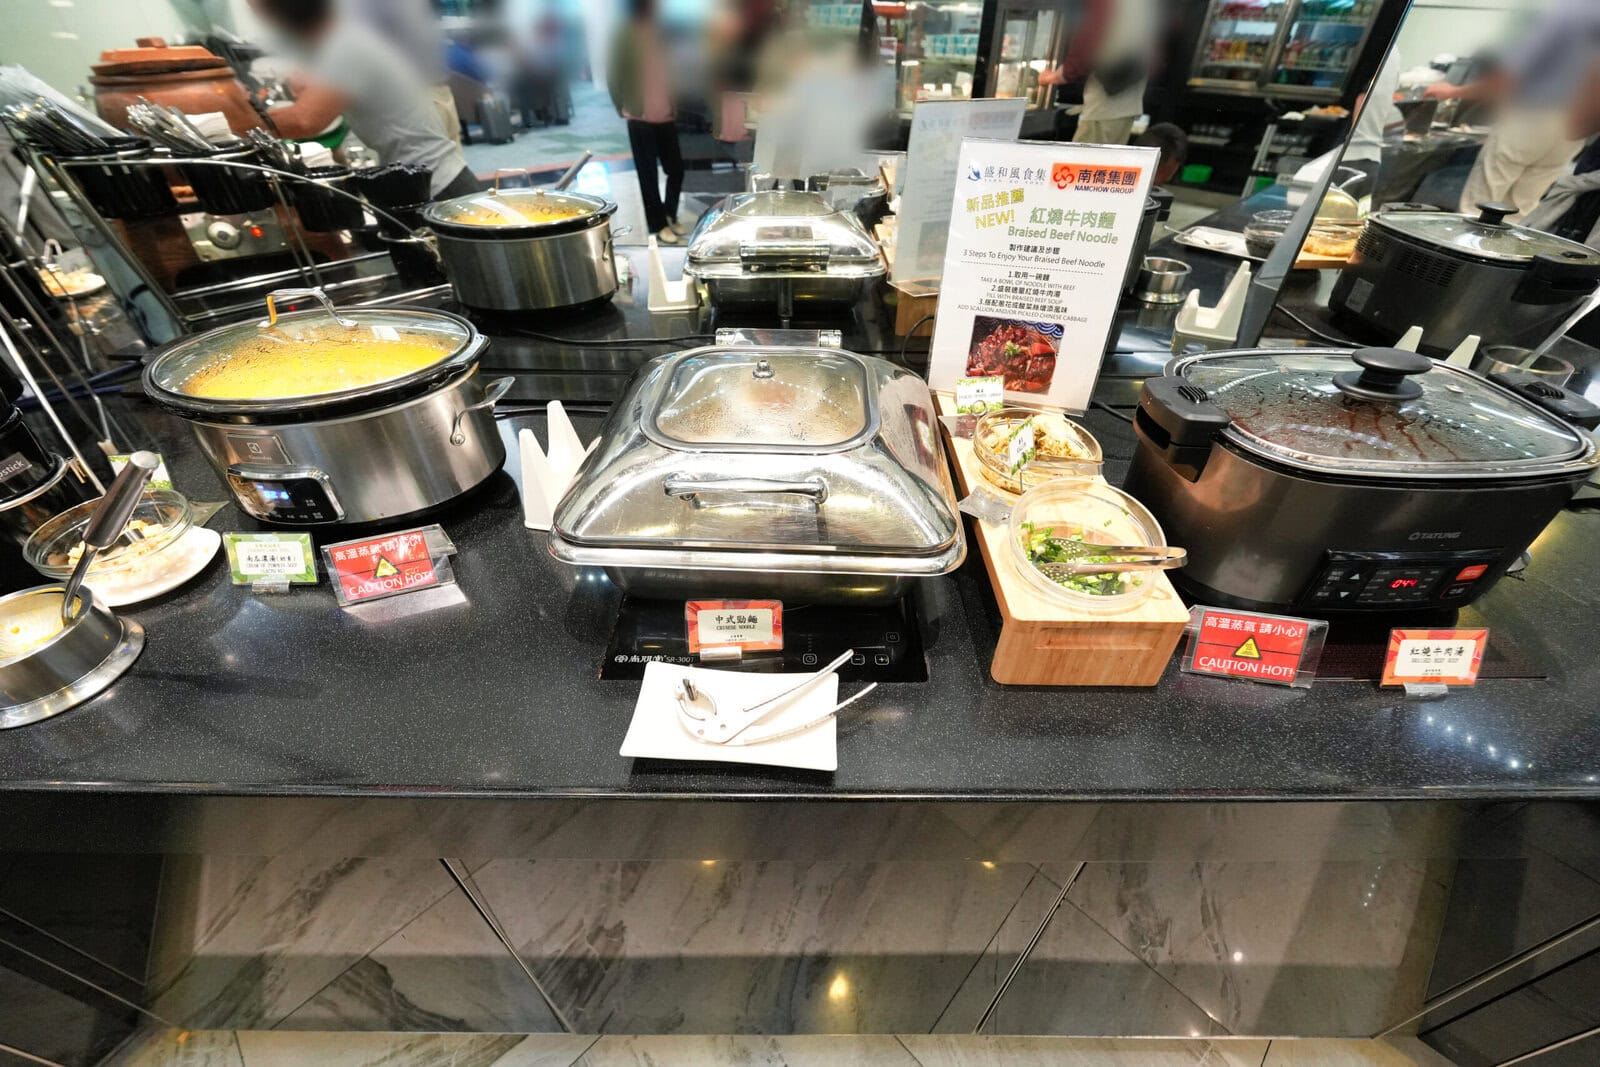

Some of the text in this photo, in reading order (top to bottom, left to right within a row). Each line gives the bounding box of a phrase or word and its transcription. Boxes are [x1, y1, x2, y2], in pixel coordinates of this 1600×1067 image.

[984, 166, 1047, 181] 盛和風食集
[1078, 169, 1137, 186] 南僑集團
[1075, 185, 1109, 193] NAMCHOW
[966, 188, 1025, 213] 新品推薦
[975, 209, 1016, 230] NEW!
[1029, 206, 1118, 230] 紅燒牛肉麵
[1008, 225, 1118, 245] Braised Beef Noodle
[968, 249, 987, 259] Steps
[997, 252, 1016, 261] Enjoy
[1017, 254, 1033, 262] Your
[1034, 255, 1060, 264] Braised
[1061, 257, 1077, 266] Beef
[1078, 259, 1106, 268] Noodle
[1023, 280, 1046, 288] NOODLE
[349, 577, 402, 596] CAUTION
[1205, 616, 1303, 638] 高溫蒸氣 請小心!
[1199, 656, 1295, 678] CAUTION HOT!
